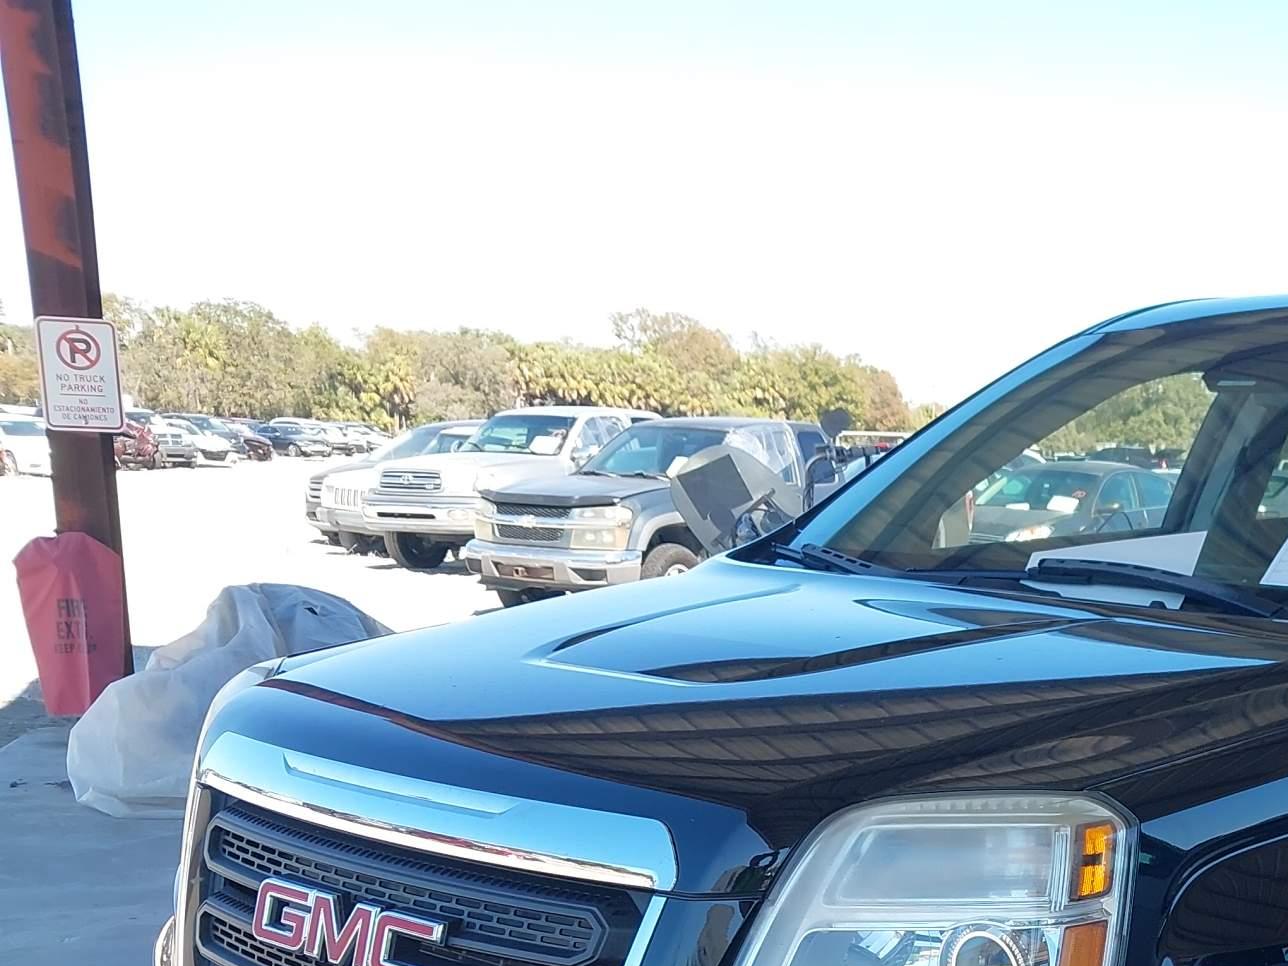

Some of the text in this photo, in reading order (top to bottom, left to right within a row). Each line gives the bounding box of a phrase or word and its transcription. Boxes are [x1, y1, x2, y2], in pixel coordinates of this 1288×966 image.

[56, 373, 106, 384] NO TRUCK
[60, 383, 104, 393] PARKING
